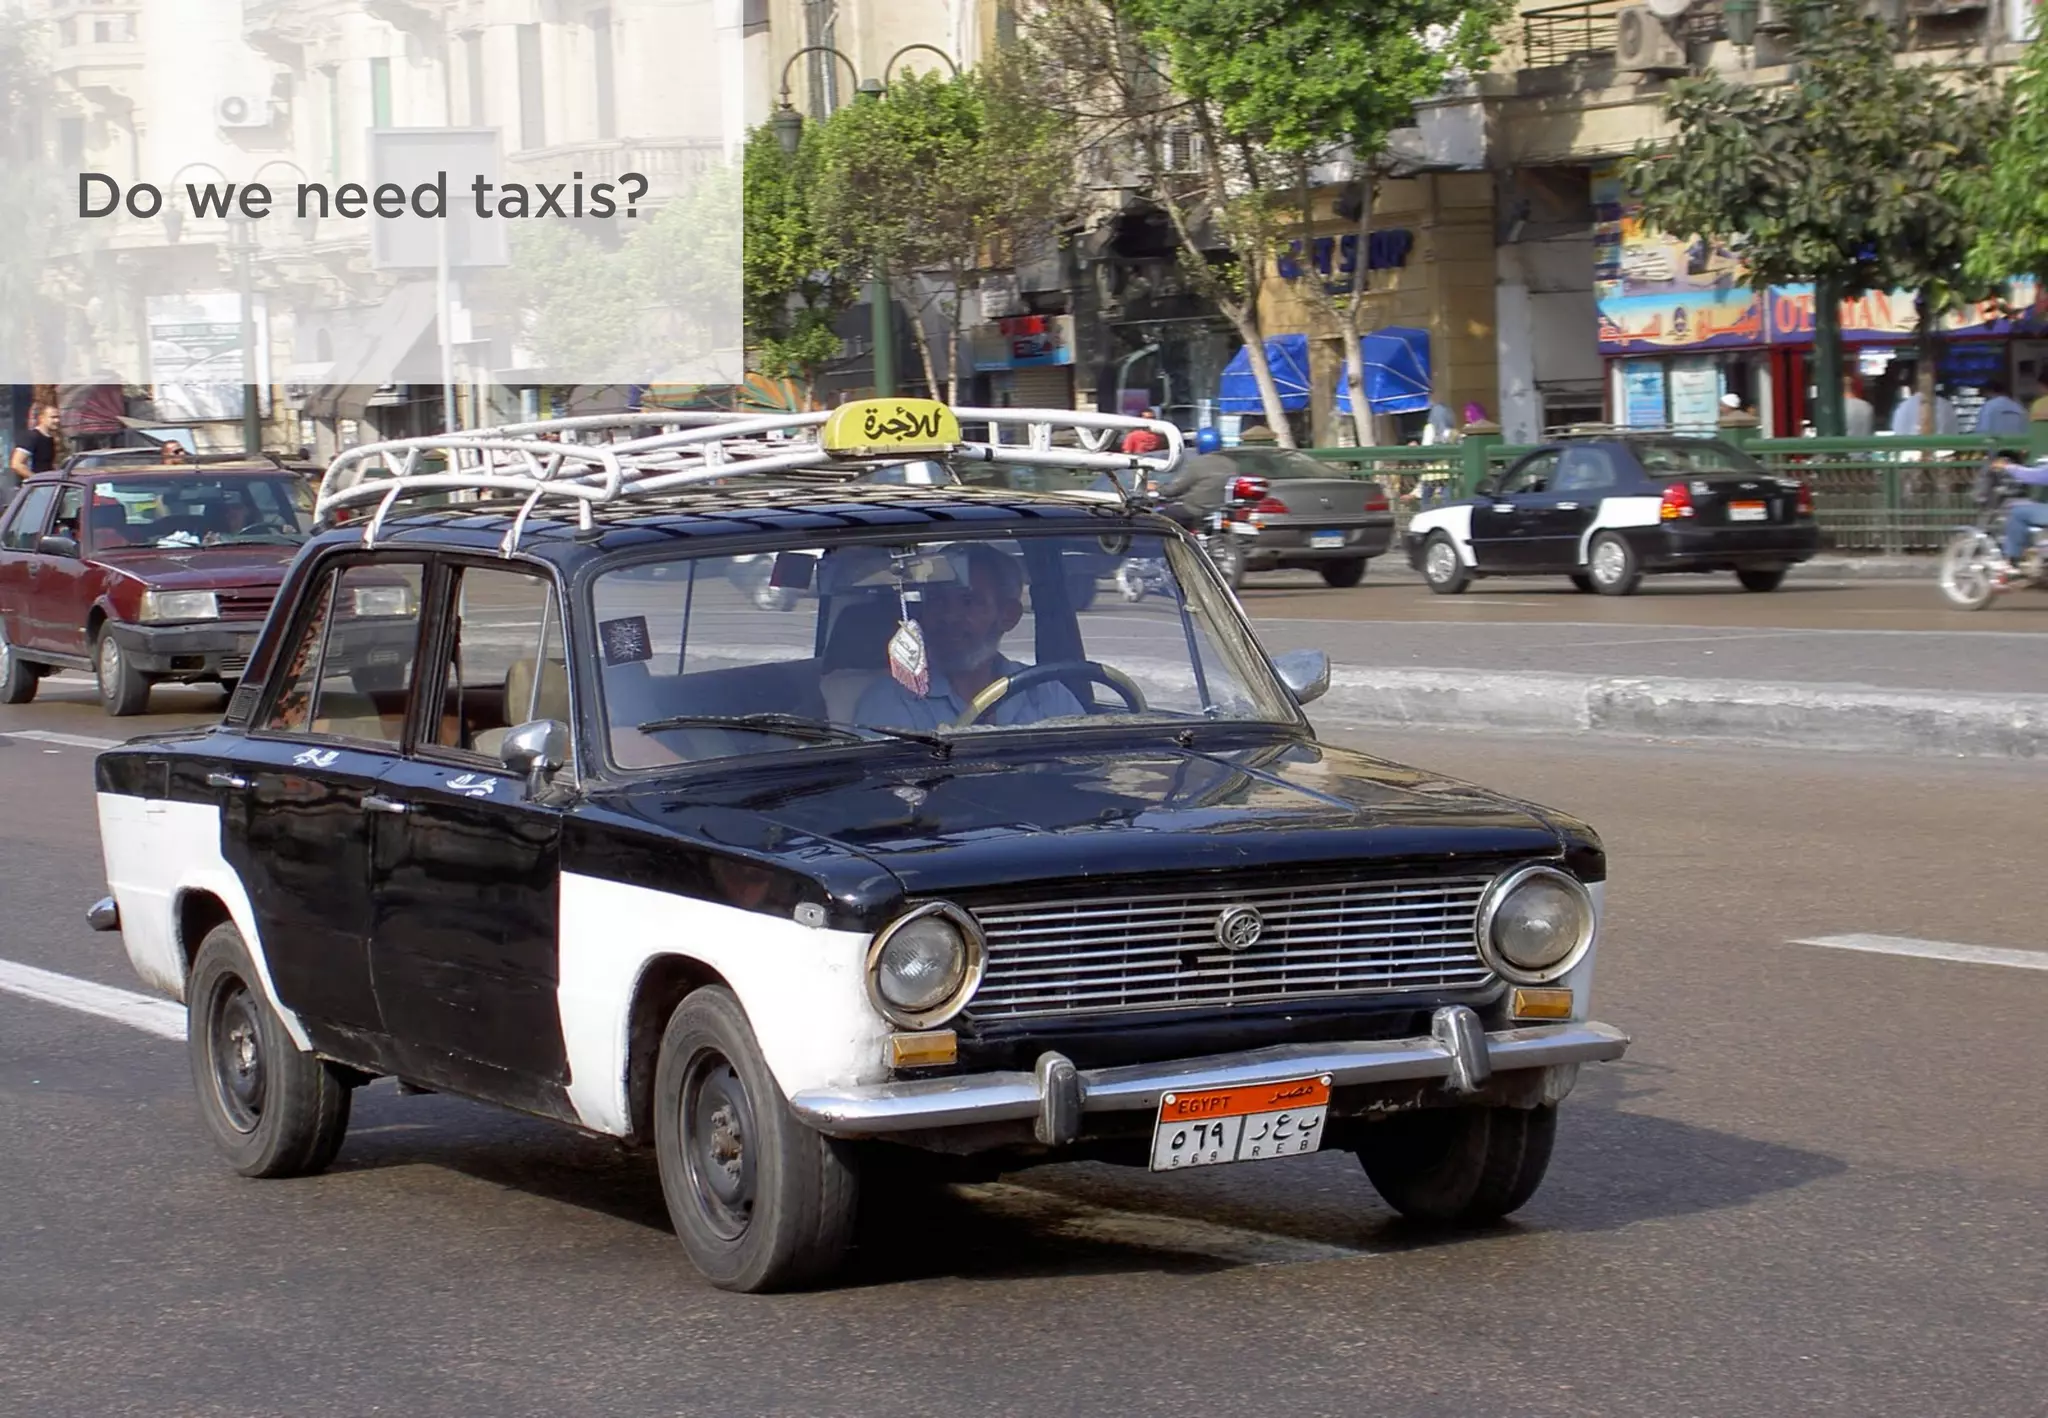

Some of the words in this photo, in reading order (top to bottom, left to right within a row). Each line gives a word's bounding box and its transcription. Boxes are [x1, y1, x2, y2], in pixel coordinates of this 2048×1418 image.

[863, 406, 942, 442] للأجرة
[1268, 1086, 1314, 1104] مصر
[1178, 1096, 1232, 1114] EGYPT
